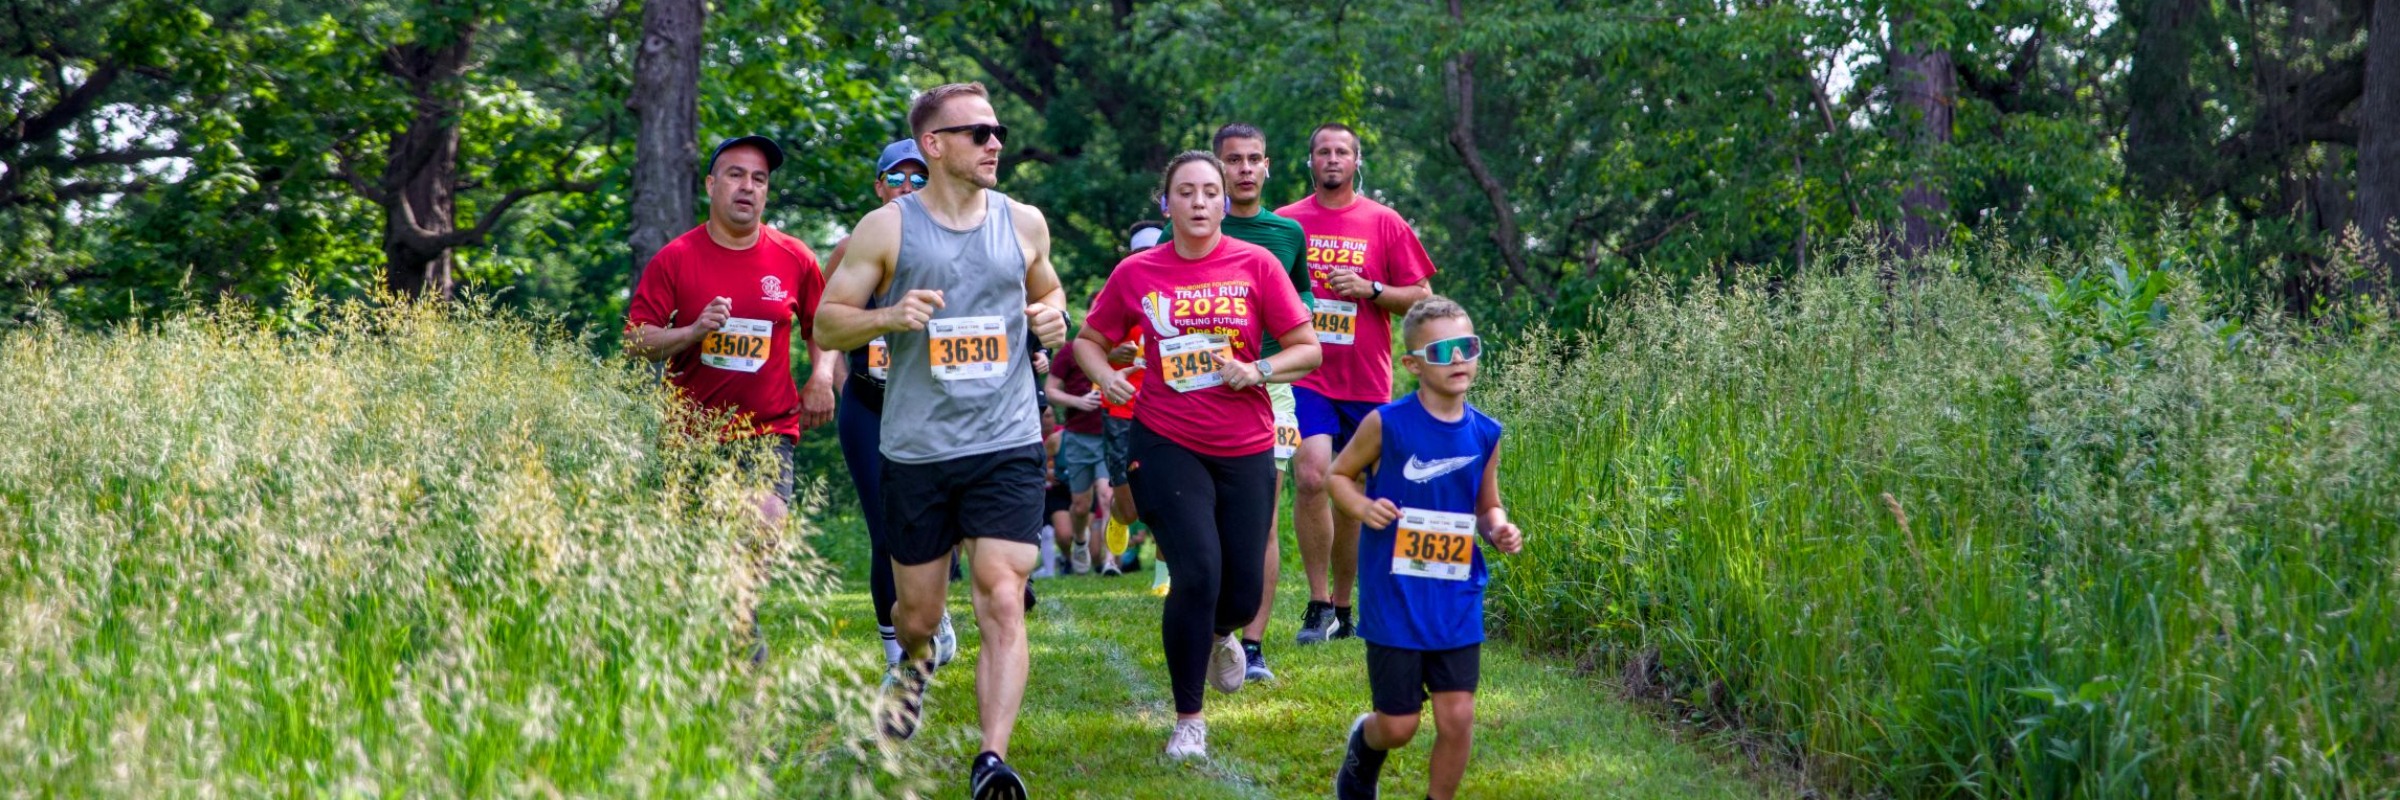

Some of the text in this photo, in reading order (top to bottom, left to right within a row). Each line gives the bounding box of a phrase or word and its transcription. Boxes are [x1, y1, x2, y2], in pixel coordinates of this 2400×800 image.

[1309, 238, 1339, 249] TRAIL
[1342, 240, 1367, 251] RUN
[1307, 247, 1364, 265] 2025
[1307, 262, 1330, 271] FUELIN
[1313, 270, 1328, 279] On
[1175, 286, 1249, 299] TRAIL RUN
[1174, 297, 1247, 316] 2025
[1174, 317, 1248, 326] FUELING FUTURES
[1214, 326, 1240, 337] Step
[710, 333, 763, 358] 3502
[940, 337, 999, 363] 3630
[1405, 531, 1465, 562] 3632
